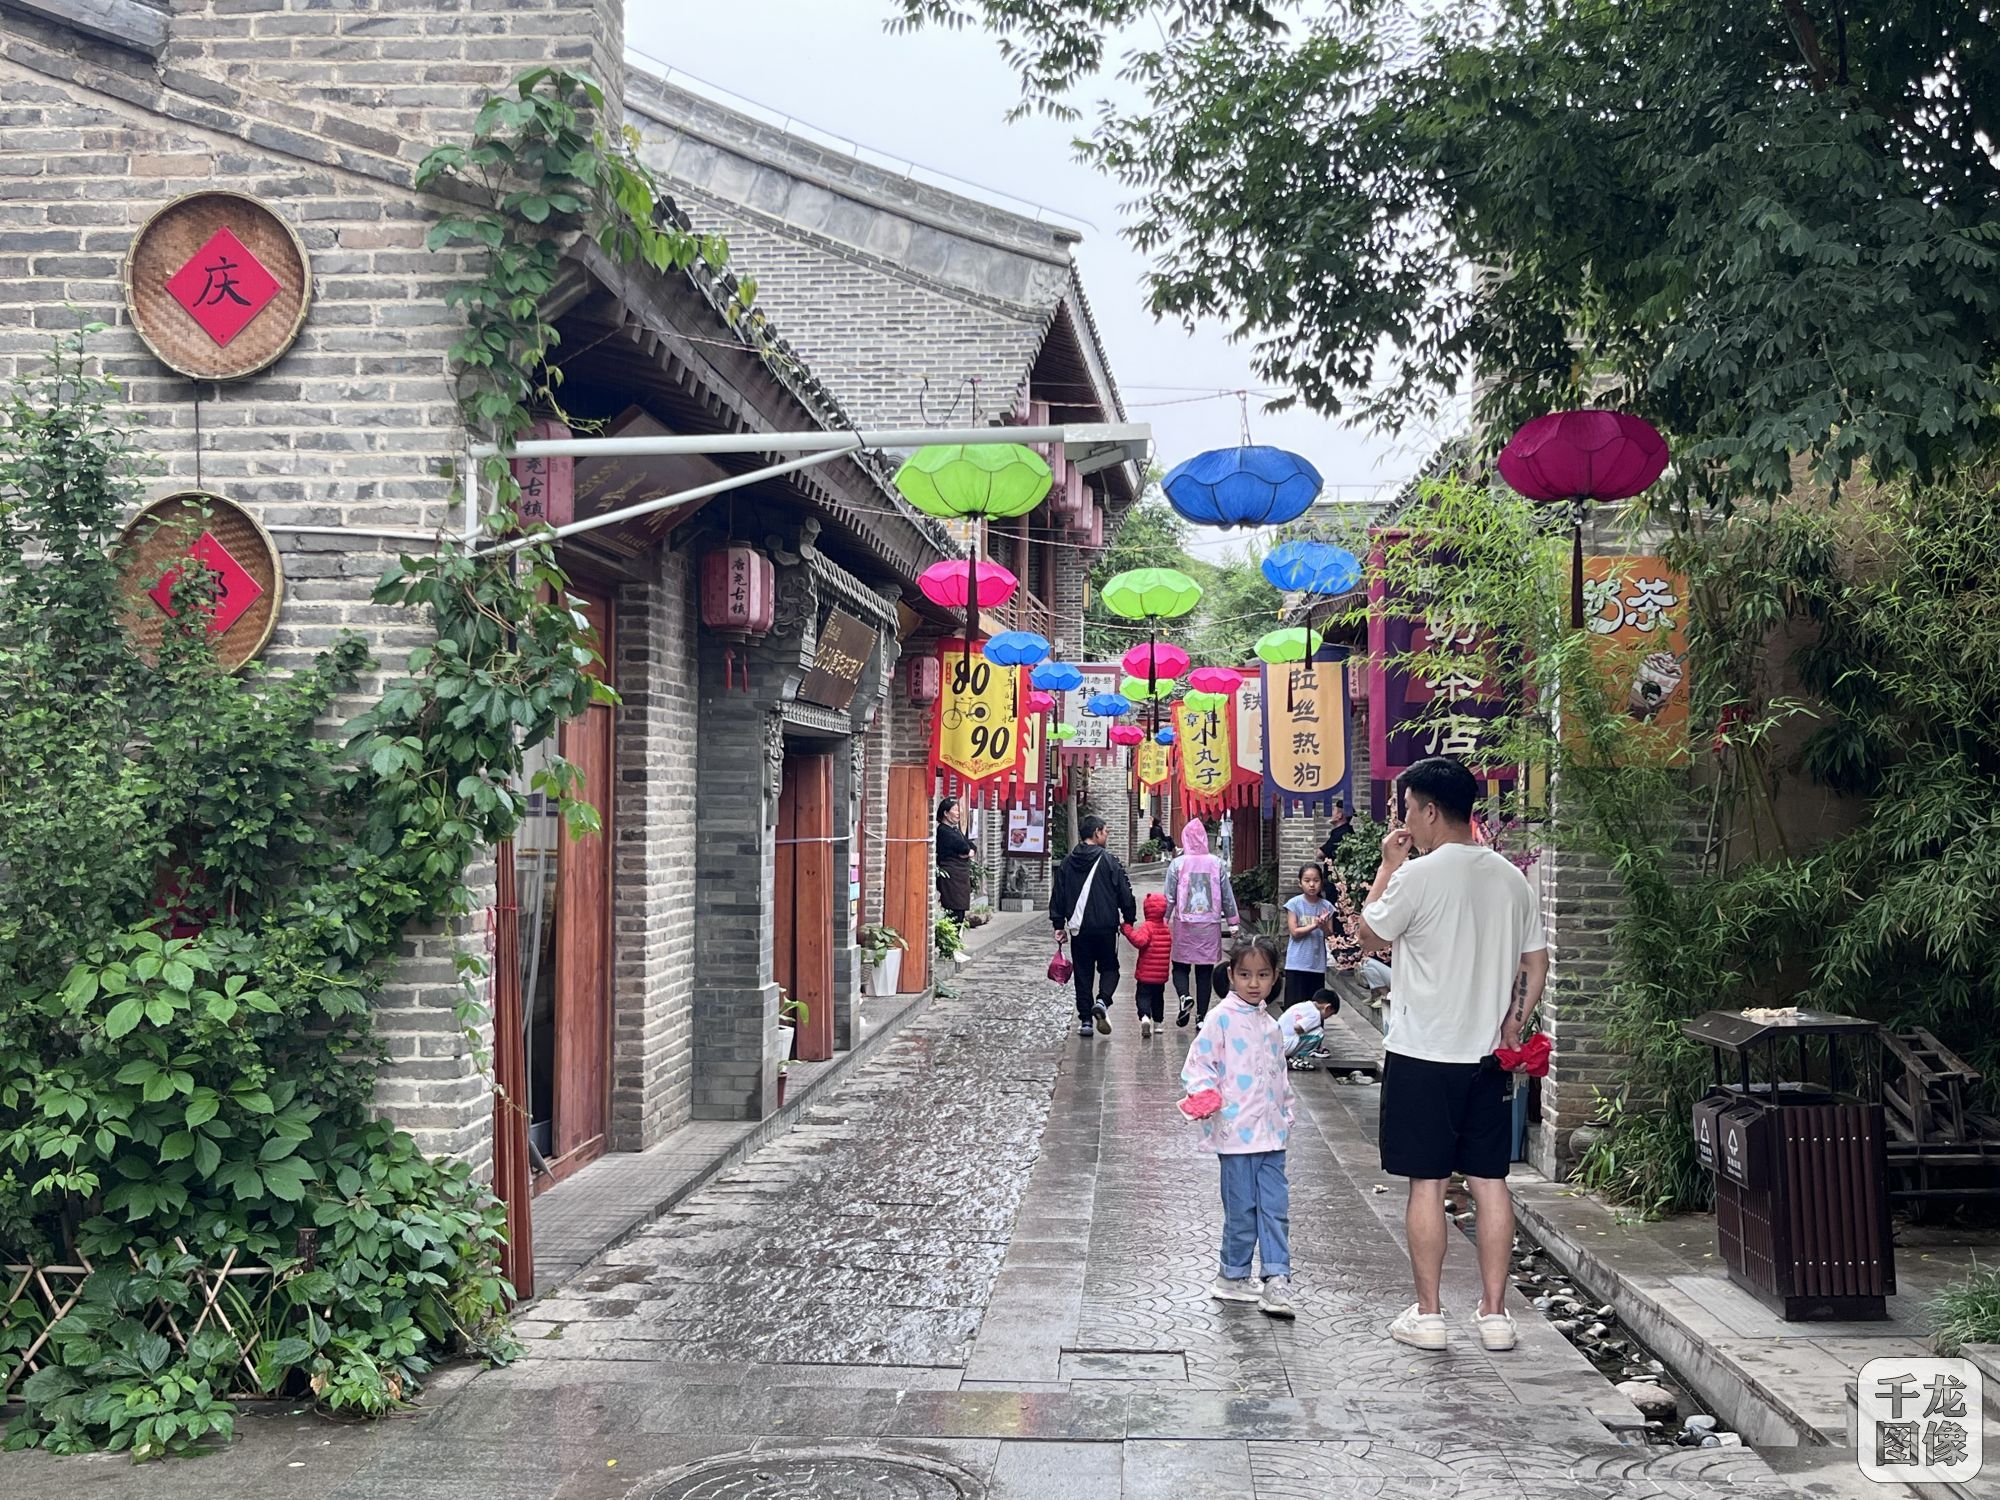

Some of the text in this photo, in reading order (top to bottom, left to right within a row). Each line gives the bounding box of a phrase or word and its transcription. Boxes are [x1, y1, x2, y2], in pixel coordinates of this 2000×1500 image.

[193, 256, 252, 307] 庆
[522, 434, 547, 519] 尧古镇
[730, 557, 747, 615] 唐尧古镇
[1582, 577, 1678, 634] 奶茶
[952, 660, 990, 695] 80
[971, 725, 1010, 759] 90
[1290, 667, 1321, 787] 拉丝热狗
